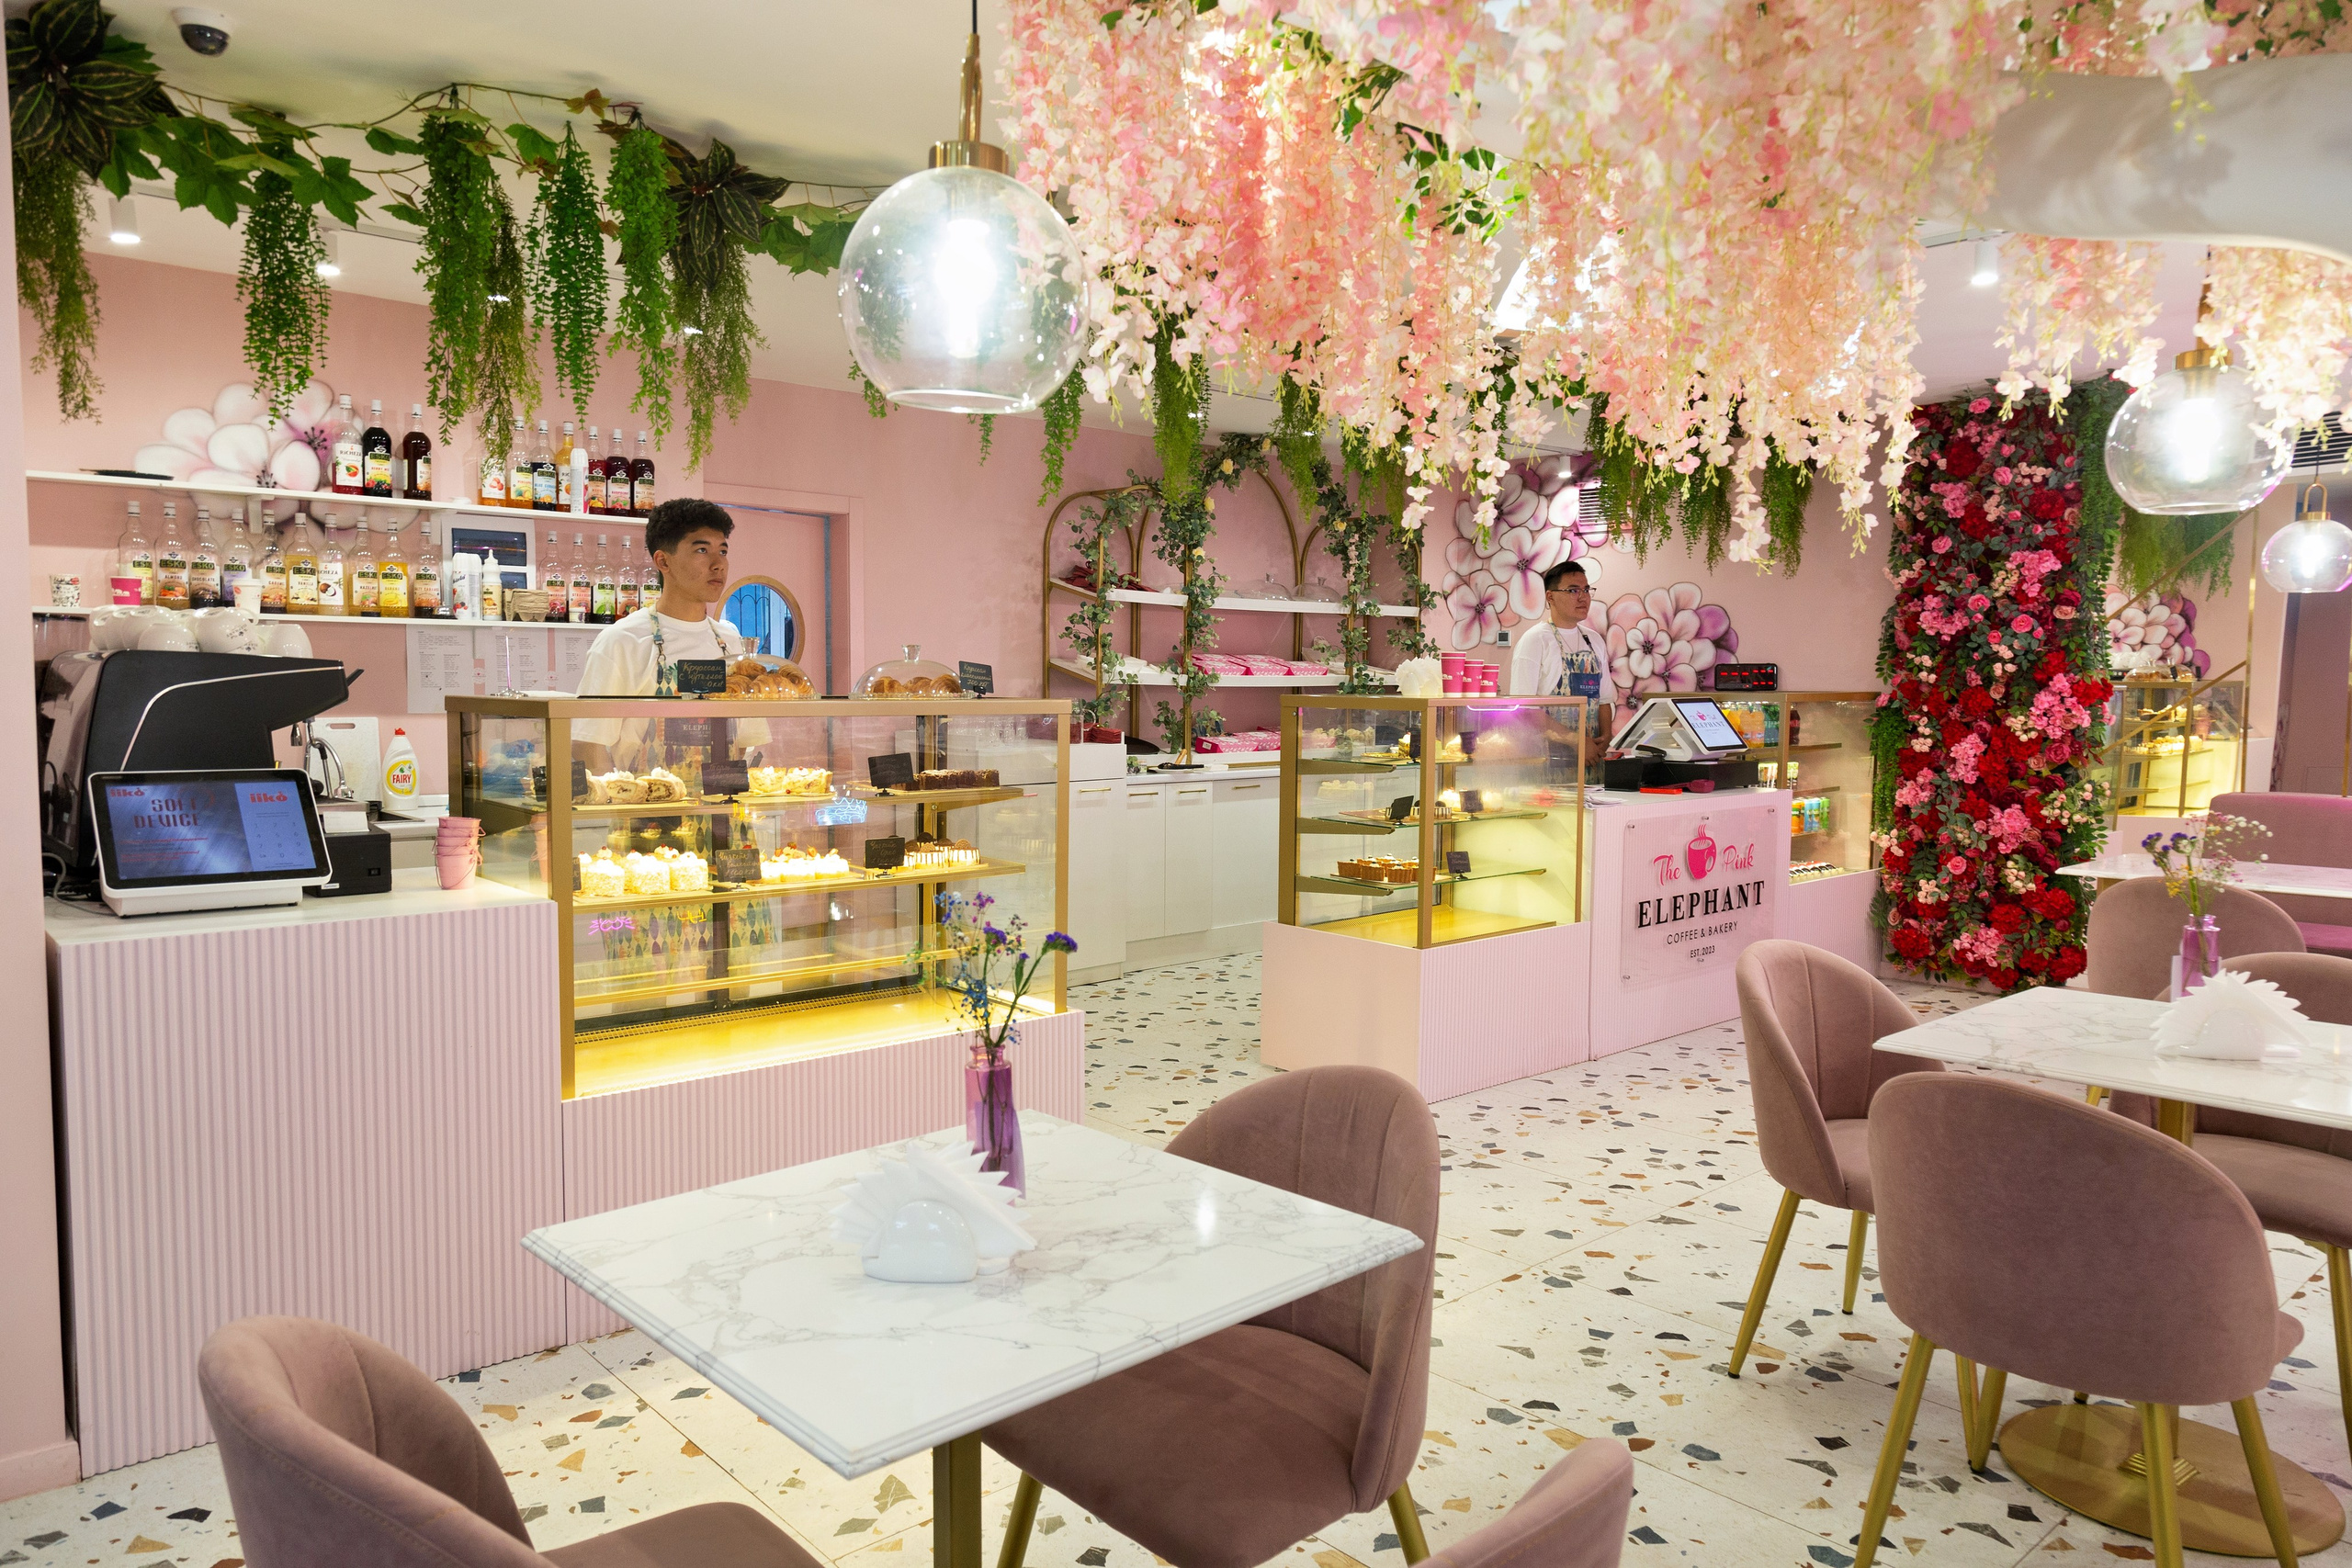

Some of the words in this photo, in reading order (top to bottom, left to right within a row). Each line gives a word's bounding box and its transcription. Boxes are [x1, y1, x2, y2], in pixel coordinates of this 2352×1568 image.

[160, 559, 186, 569] ESKO
[392, 774, 412, 784] FAIRY
[133, 813, 198, 828] DEVICE
[1654, 854, 1681, 886] The
[1723, 843, 1754, 872] Pink
[1637, 880, 1765, 929] ELEPHANT
[1667, 929, 1698, 944] COFFEE
[1700, 928, 1706, 938] &
[1708, 920, 1738, 936] BAKERY
